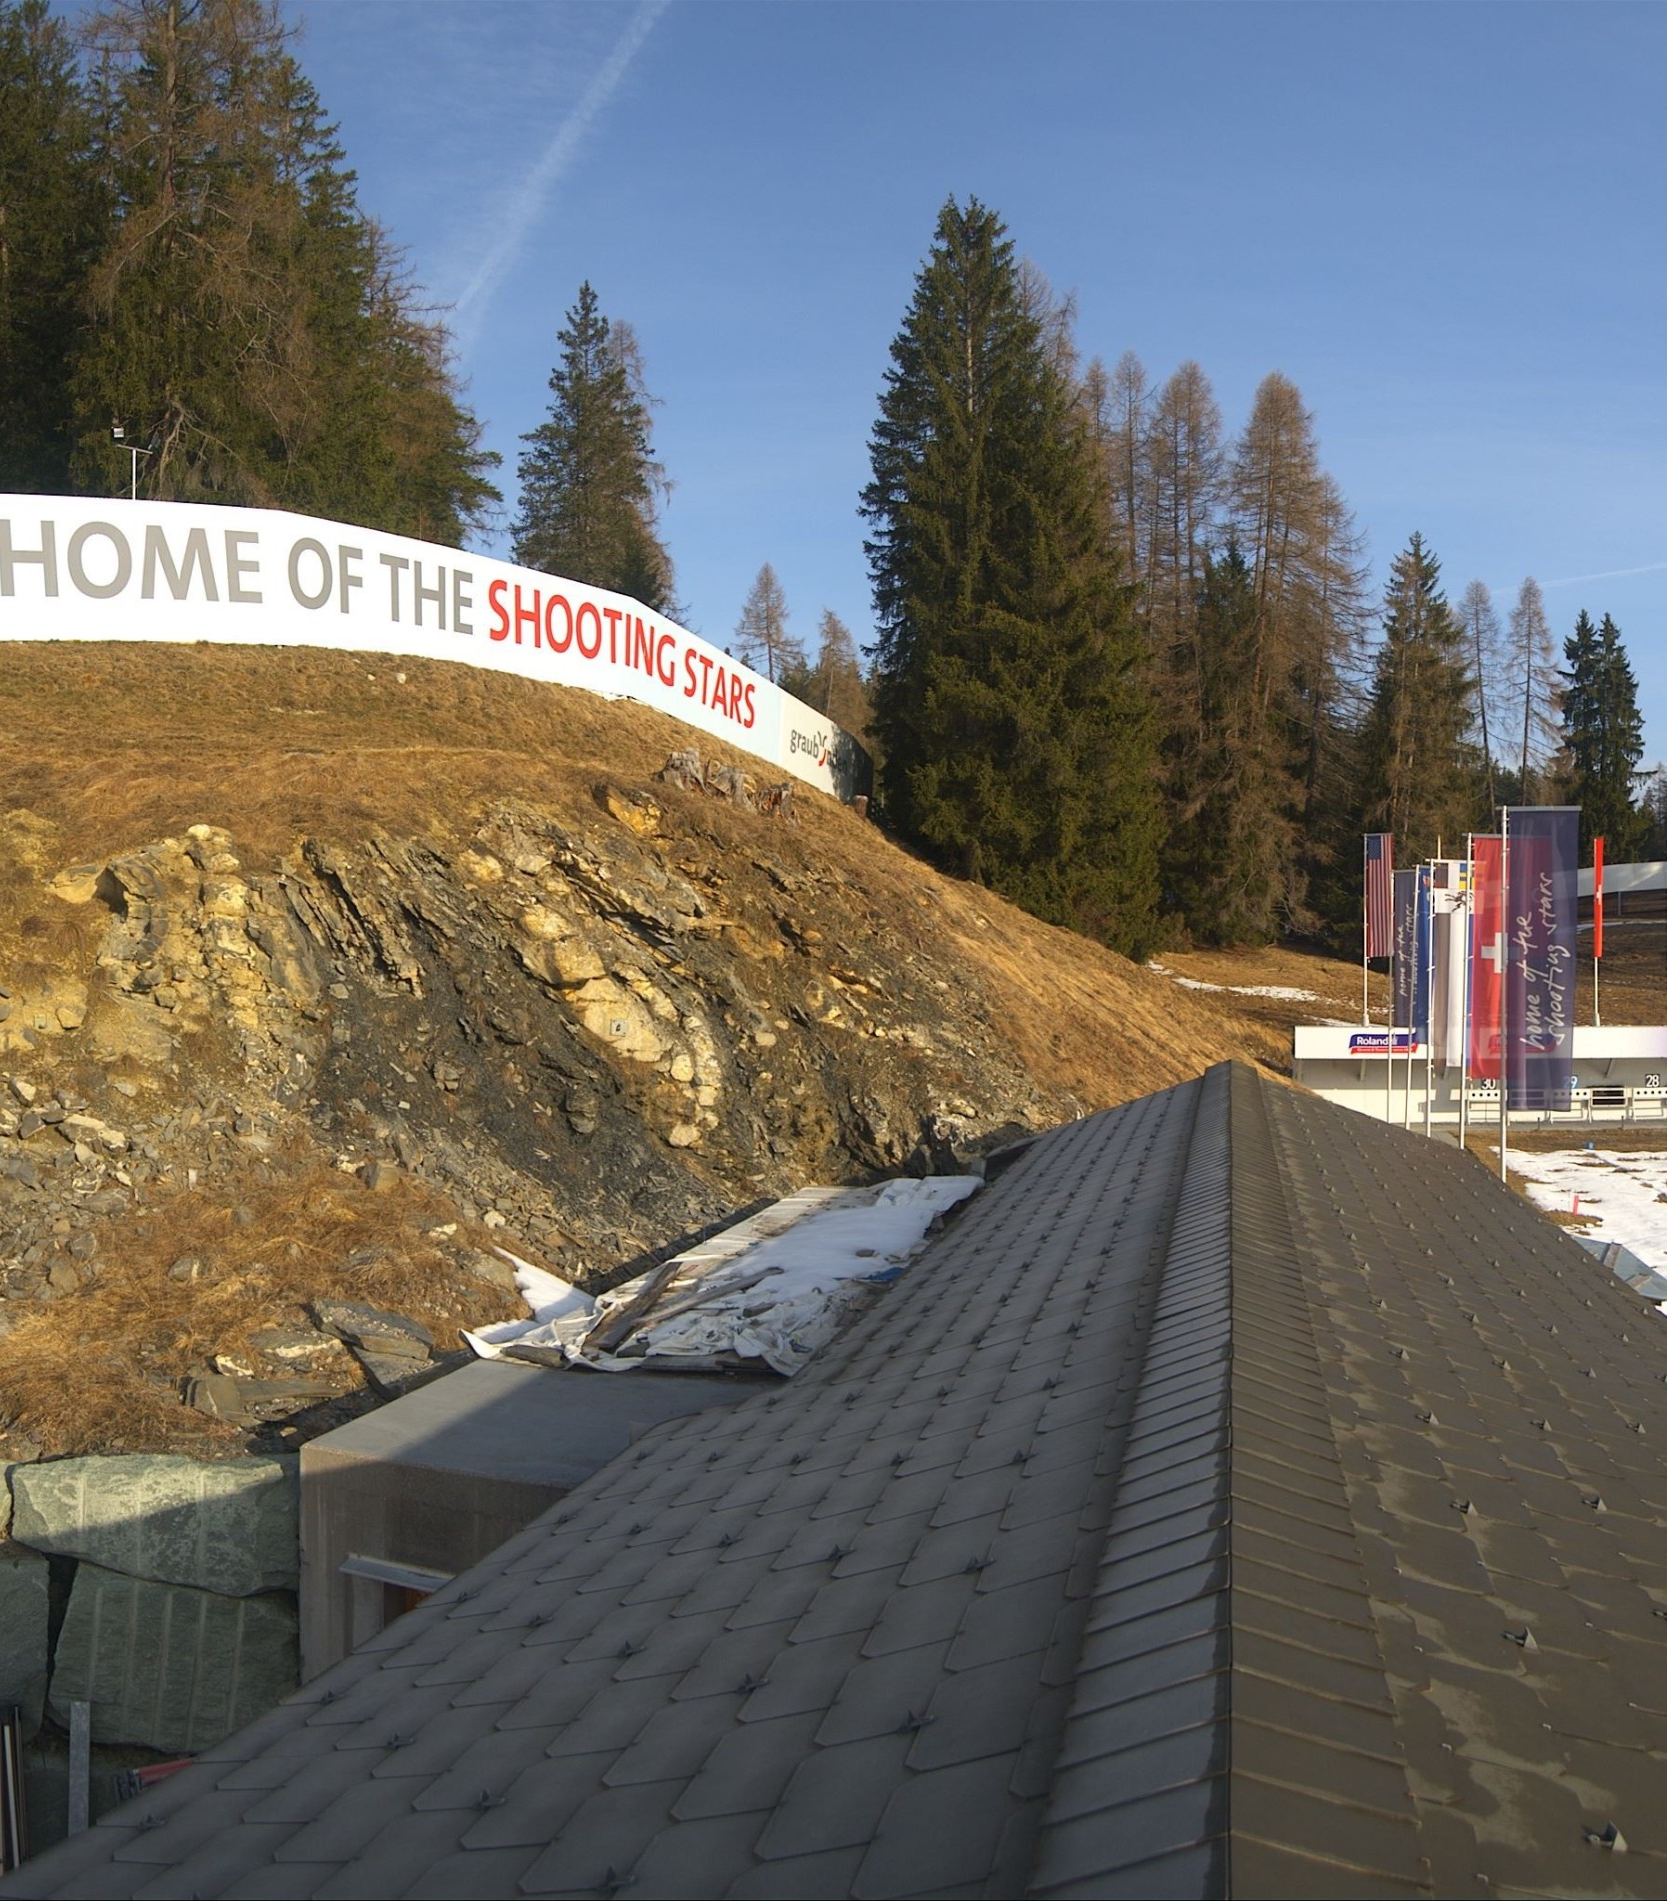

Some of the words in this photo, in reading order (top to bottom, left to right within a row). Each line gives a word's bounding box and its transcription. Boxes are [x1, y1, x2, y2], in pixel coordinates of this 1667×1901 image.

[288, 536, 364, 614] OF
[379, 552, 474, 636] THE
[488, 579, 676, 688] SHOOTING
[684, 648, 756, 729] STARS
[1538, 872, 1558, 935] stars
[1517, 960, 1549, 982] of
[1545, 944, 1571, 1046] shooting
[1356, 1036, 1391, 1046] Roland
[1520, 993, 1545, 1051] home
[1481, 1078, 1496, 1090] 30
[1646, 1075, 1660, 1087] 28
